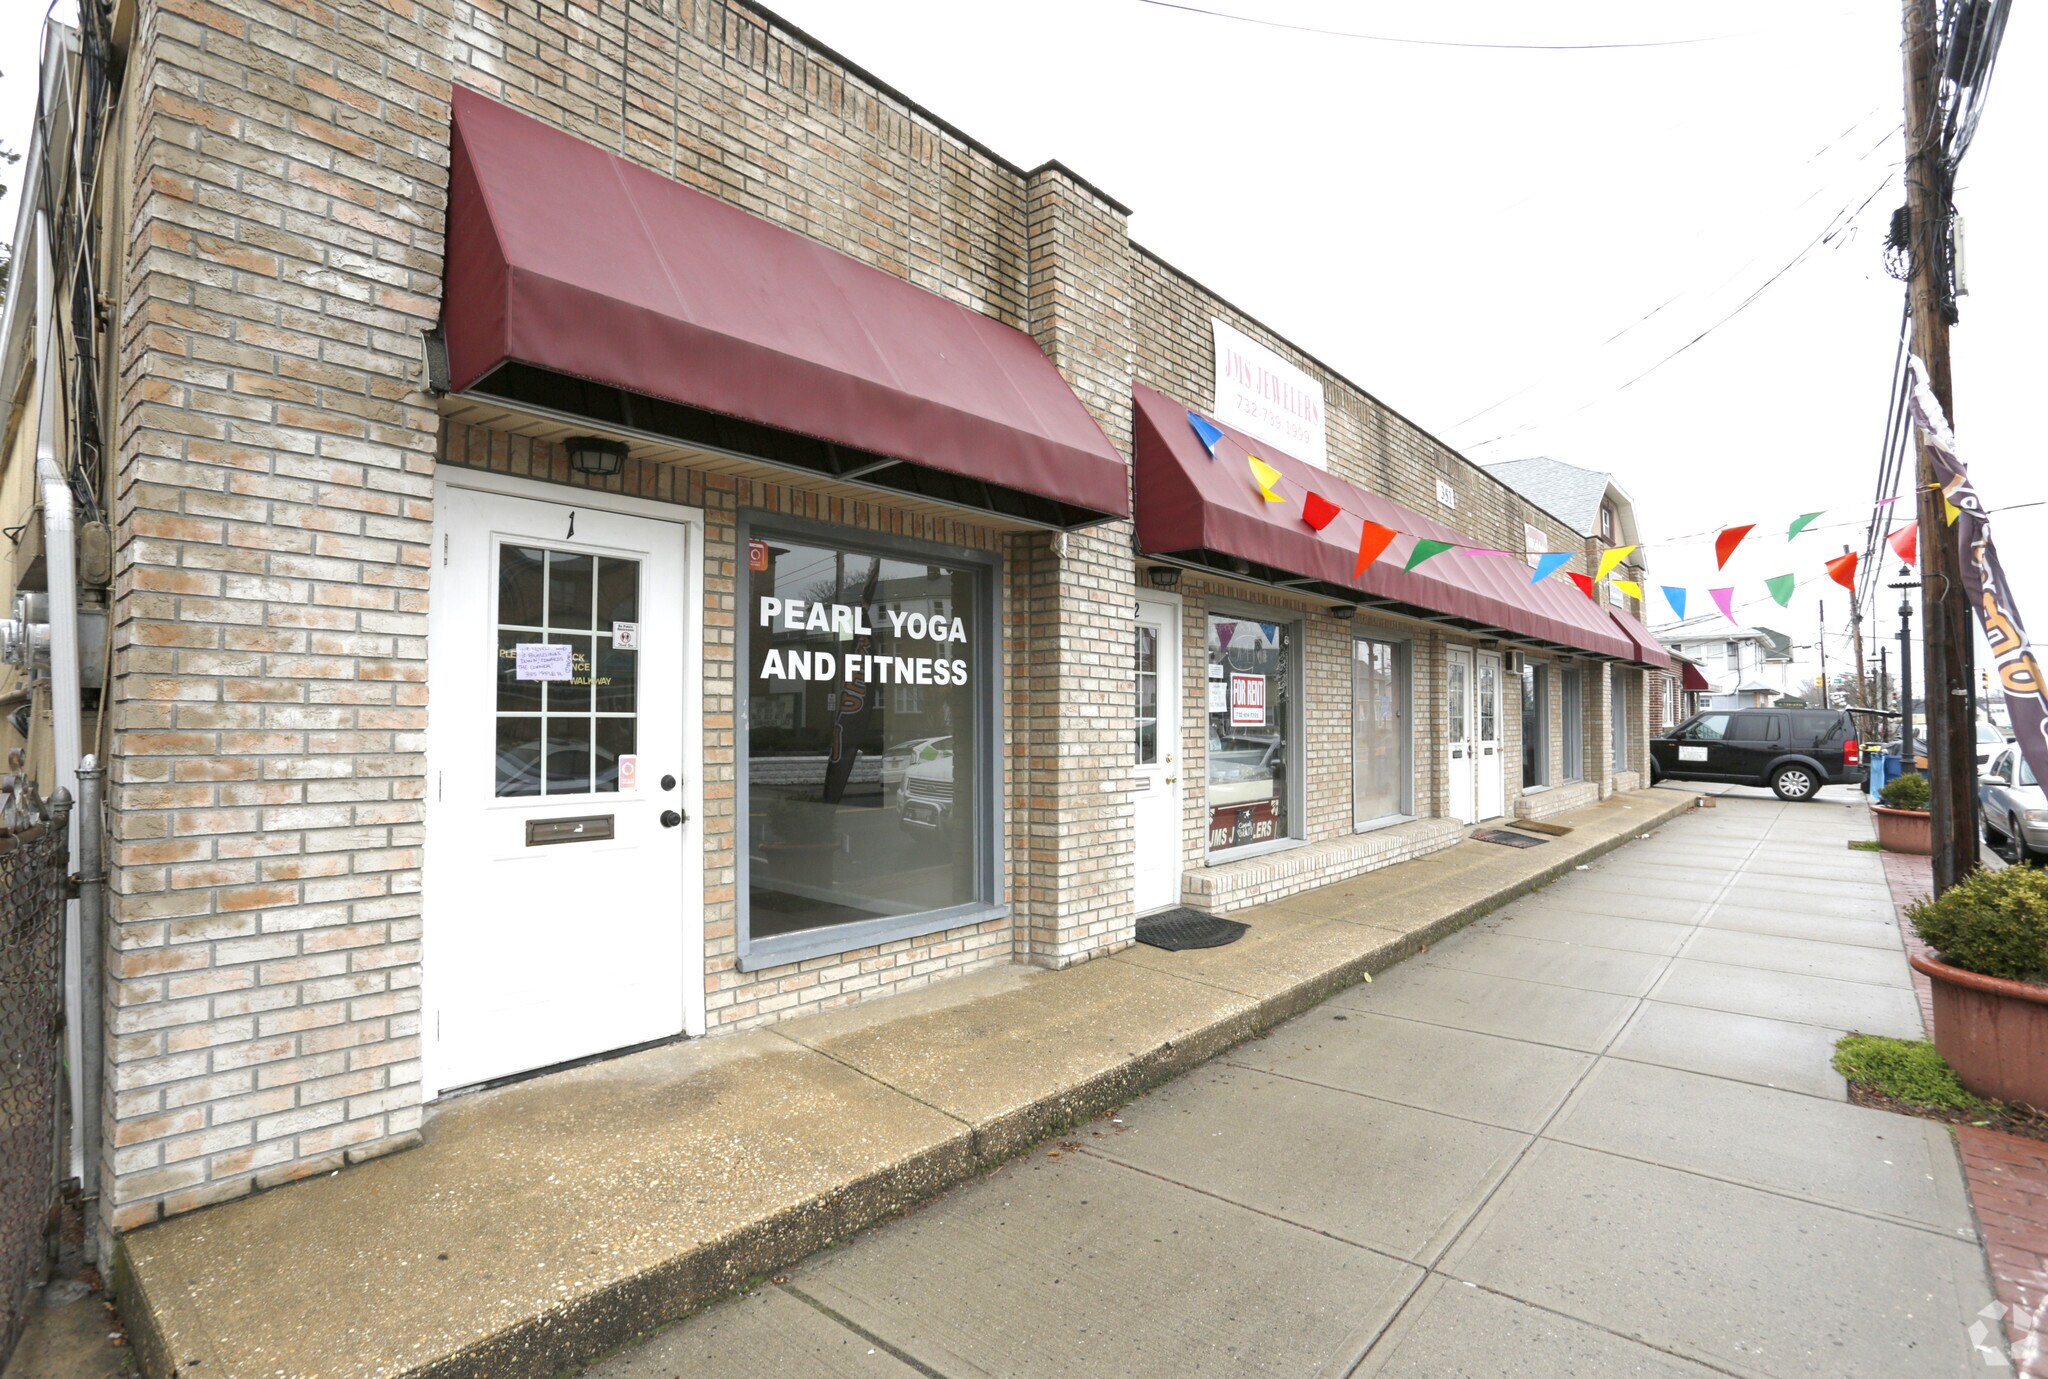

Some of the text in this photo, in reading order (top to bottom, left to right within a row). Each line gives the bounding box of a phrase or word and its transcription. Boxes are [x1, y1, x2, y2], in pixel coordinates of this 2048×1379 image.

[1256, 366, 1319, 427] JEWELERS
[566, 510, 575, 540] 1
[760, 595, 968, 644] PEARL YOGA
[1134, 602, 1140, 619] 2
[499, 649, 517, 659] PLE
[760, 648, 968, 686] AND FITNESS
[570, 676, 612, 686] WALKWAY
[1233, 678, 1247, 706] FOR
[1247, 679, 1264, 707] RENT
[1209, 827, 1228, 848] JMS
